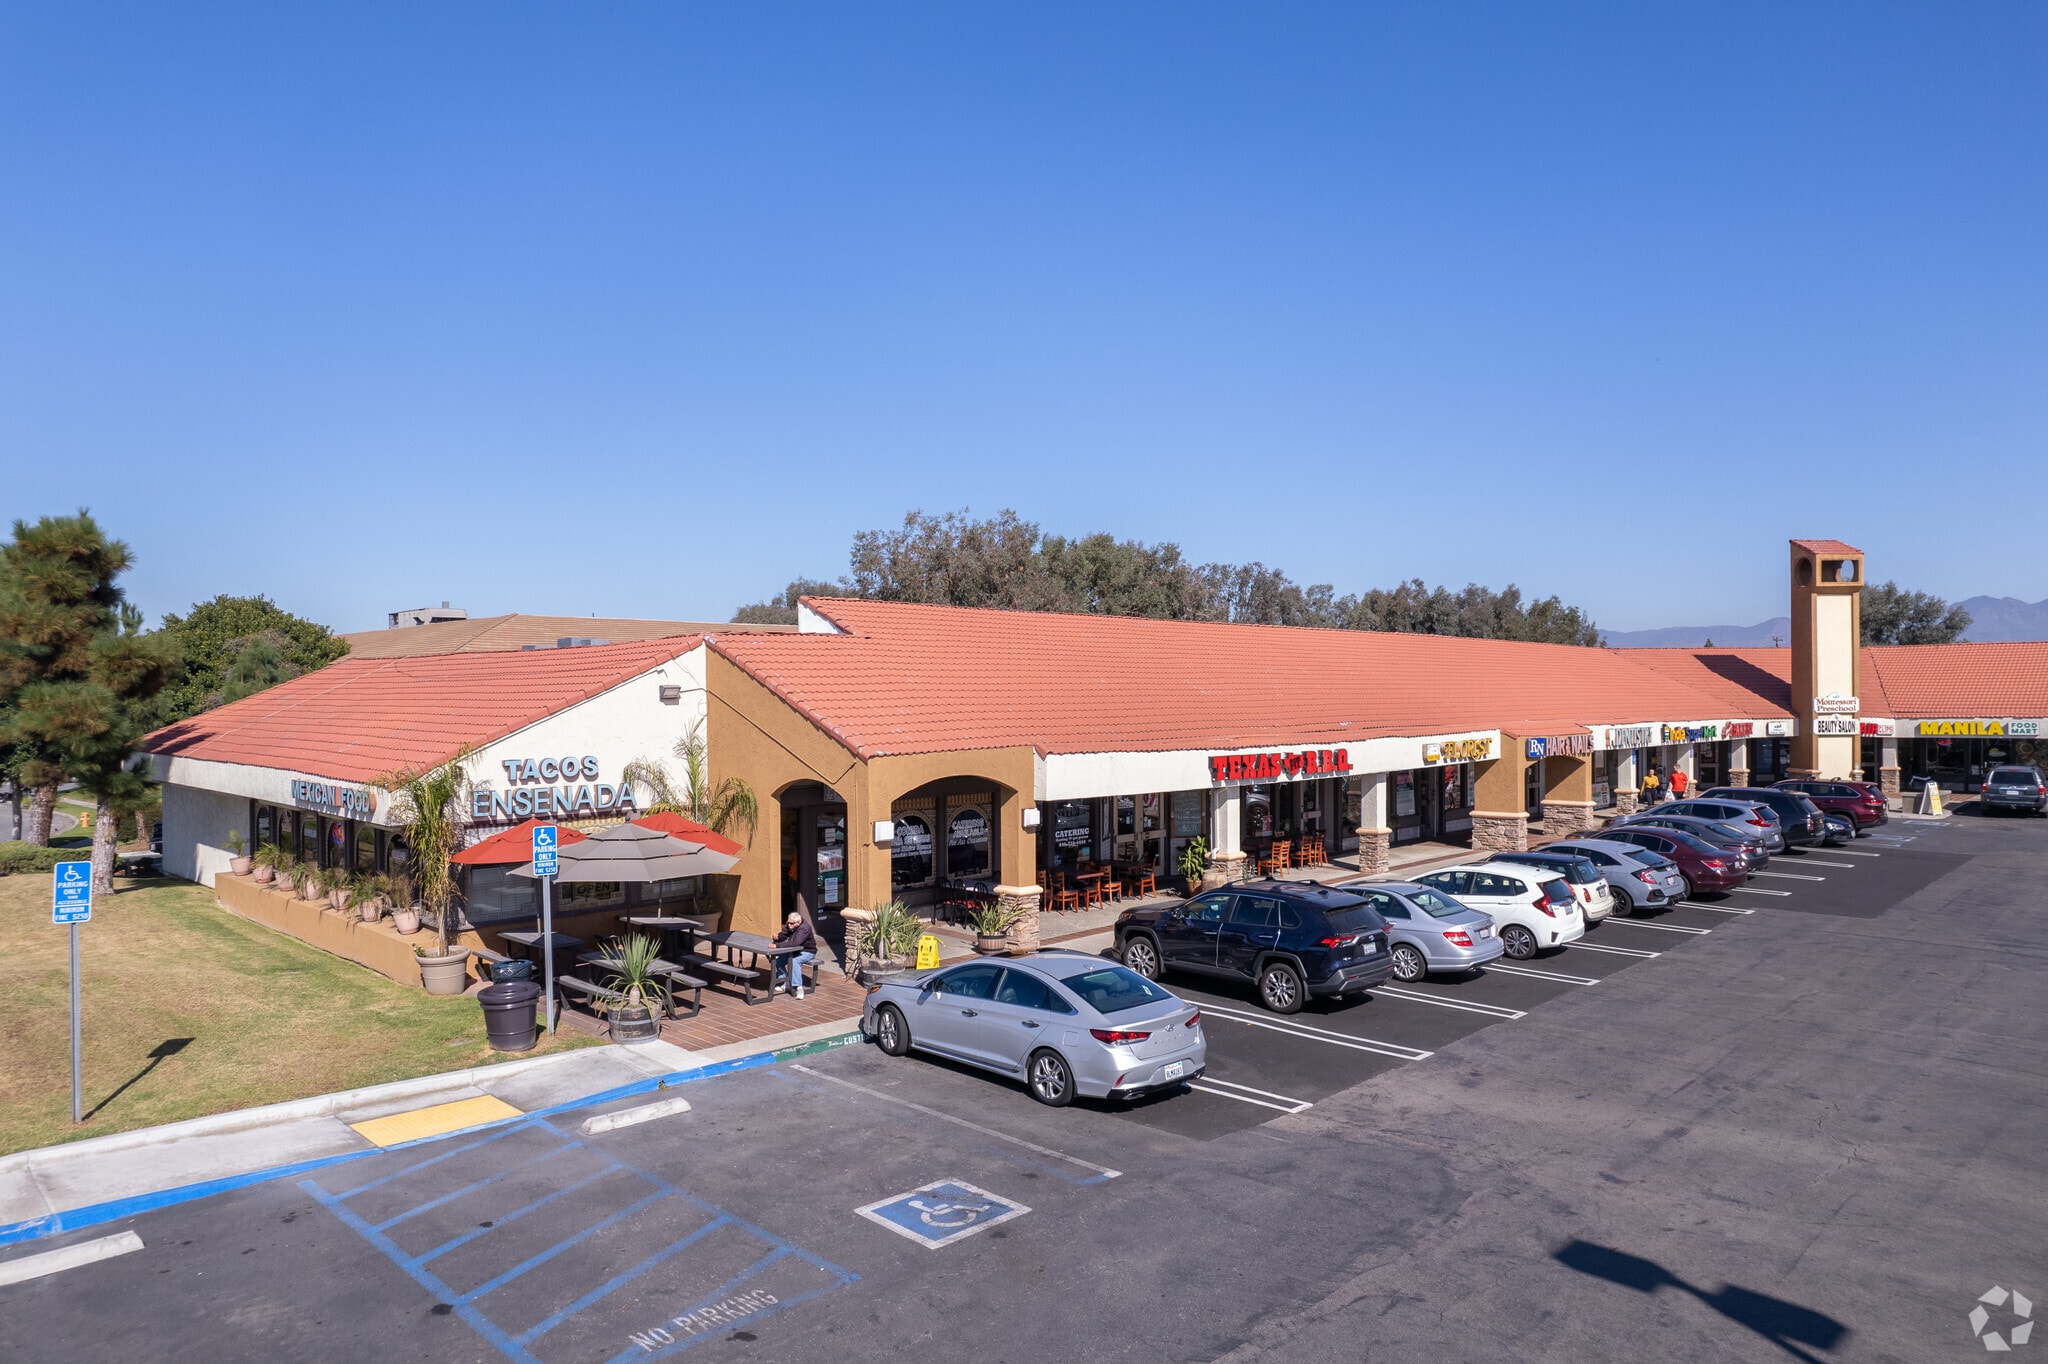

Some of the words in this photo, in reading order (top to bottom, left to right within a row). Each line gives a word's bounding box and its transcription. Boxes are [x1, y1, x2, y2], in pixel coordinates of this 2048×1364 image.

[1818, 720, 1837, 733] BEAUTY
[1838, 720, 1856, 733] SALON
[1919, 721, 2004, 736] MANILA
[1443, 738, 1493, 761] FLORIST
[1546, 737, 1566, 756] HAIR
[1570, 735, 1594, 754] NAILS
[503, 756, 599, 782] TACOS
[1210, 753, 1282, 781] TEXAS
[291, 780, 337, 806] MEXICAN
[341, 788, 371, 812] FOOD
[473, 783, 637, 817] ENSENADA
[1055, 828, 1090, 838] CATERING
[534, 845, 556, 853] PARKING
[57, 881, 89, 889] PARKING
[628, 1327, 676, 1353] NO
[672, 1289, 779, 1335] PARKING
